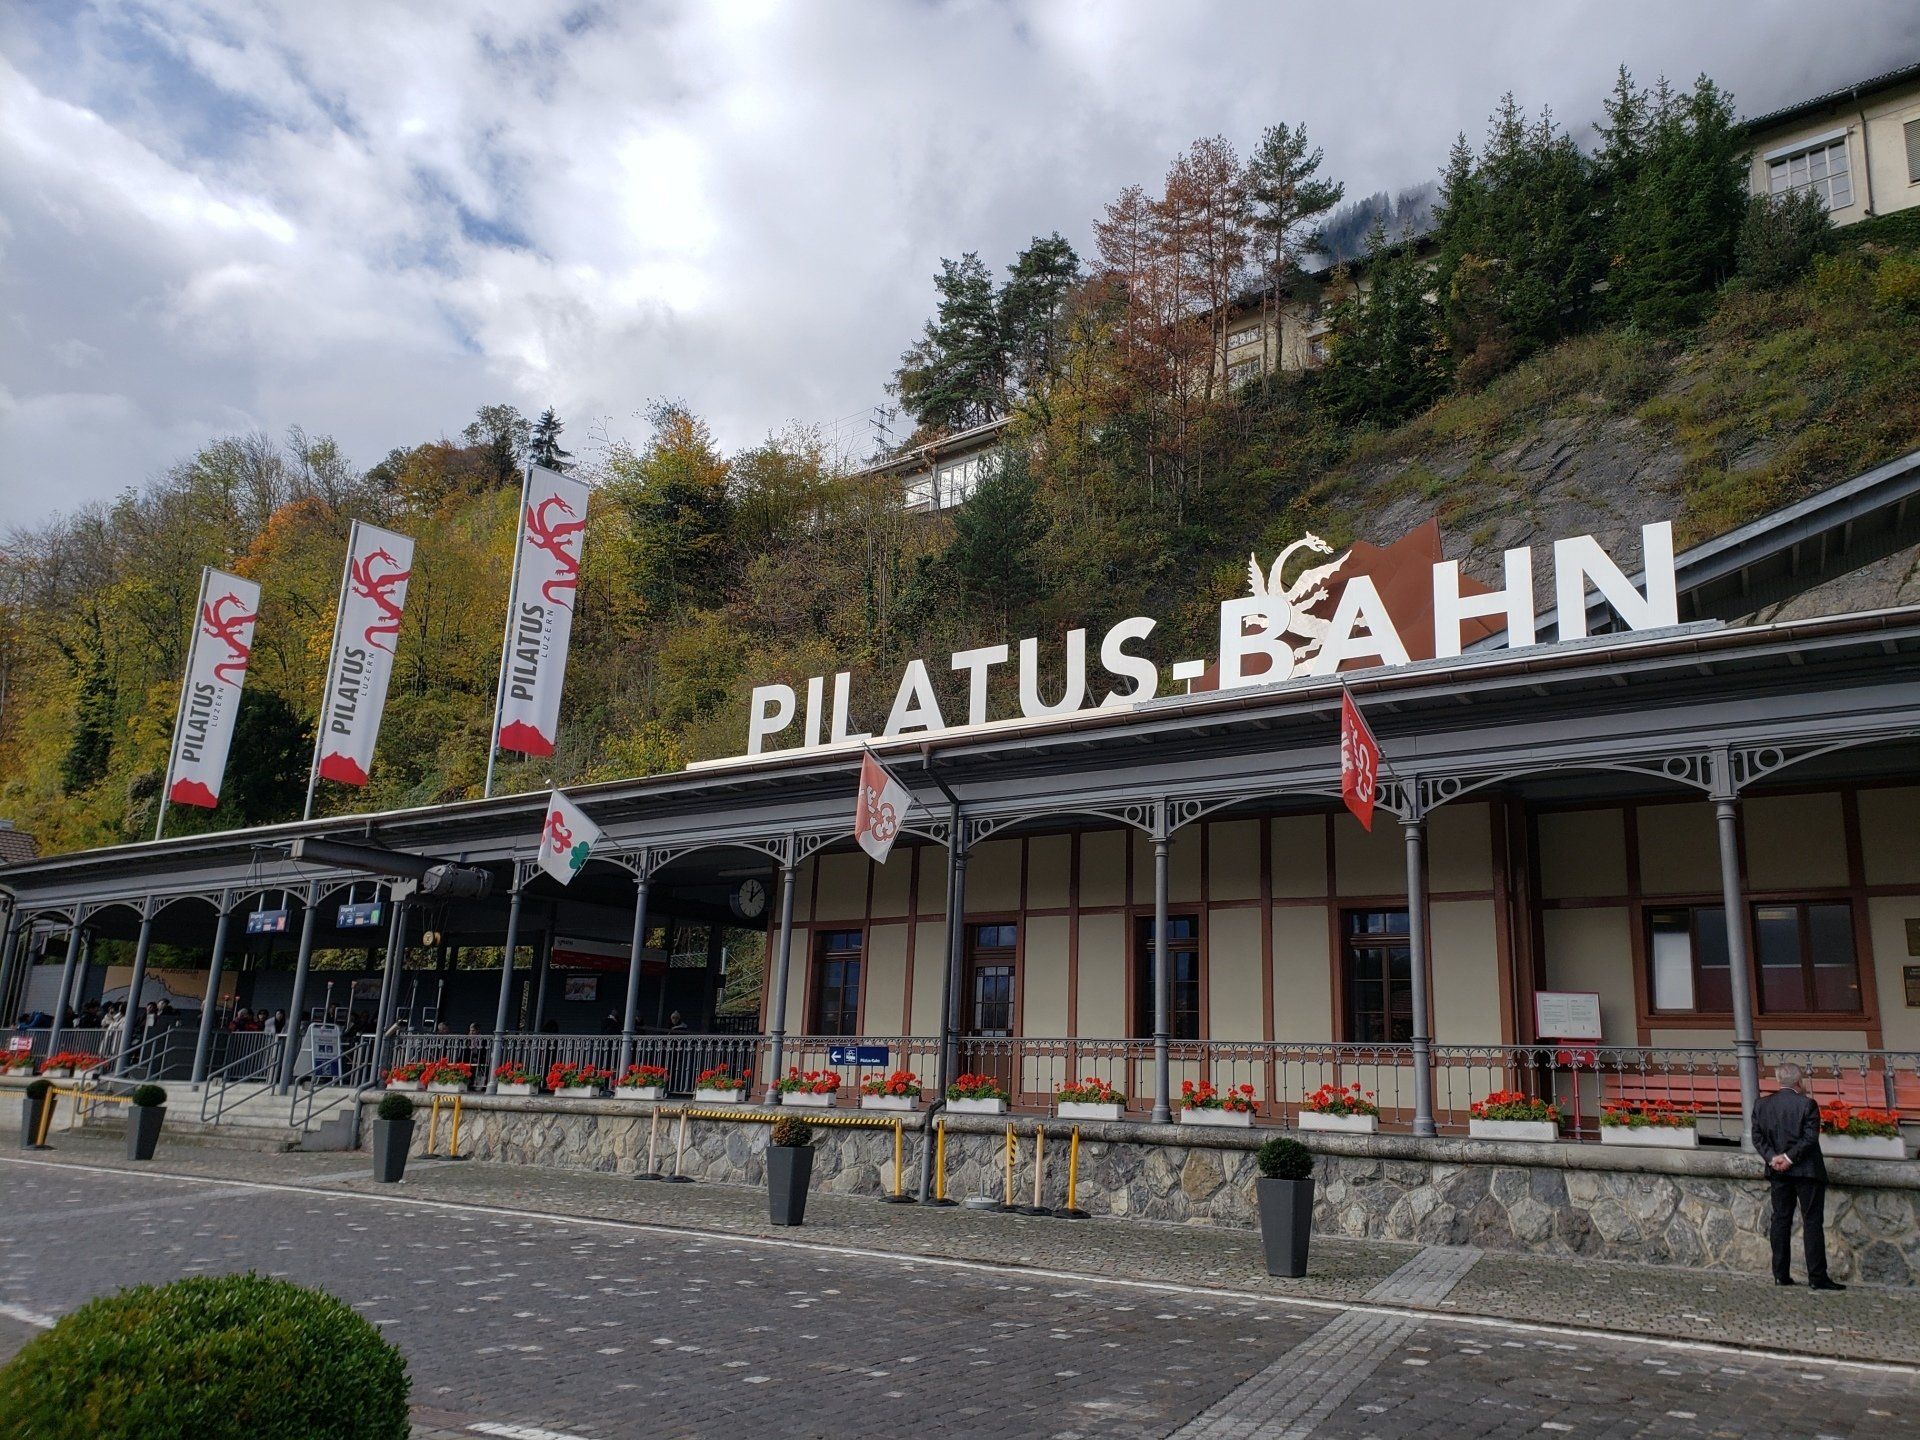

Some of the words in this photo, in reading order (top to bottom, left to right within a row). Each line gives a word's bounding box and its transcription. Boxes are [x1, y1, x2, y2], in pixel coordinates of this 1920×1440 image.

[510, 602, 545, 701] PILATUS
[541, 609, 554, 658] LUZERN
[331, 646, 366, 736] PILATUS
[361, 652, 375, 697] LUZERN
[181, 681, 216, 763] PILATUS
[211, 687, 225, 728] LUZERN
